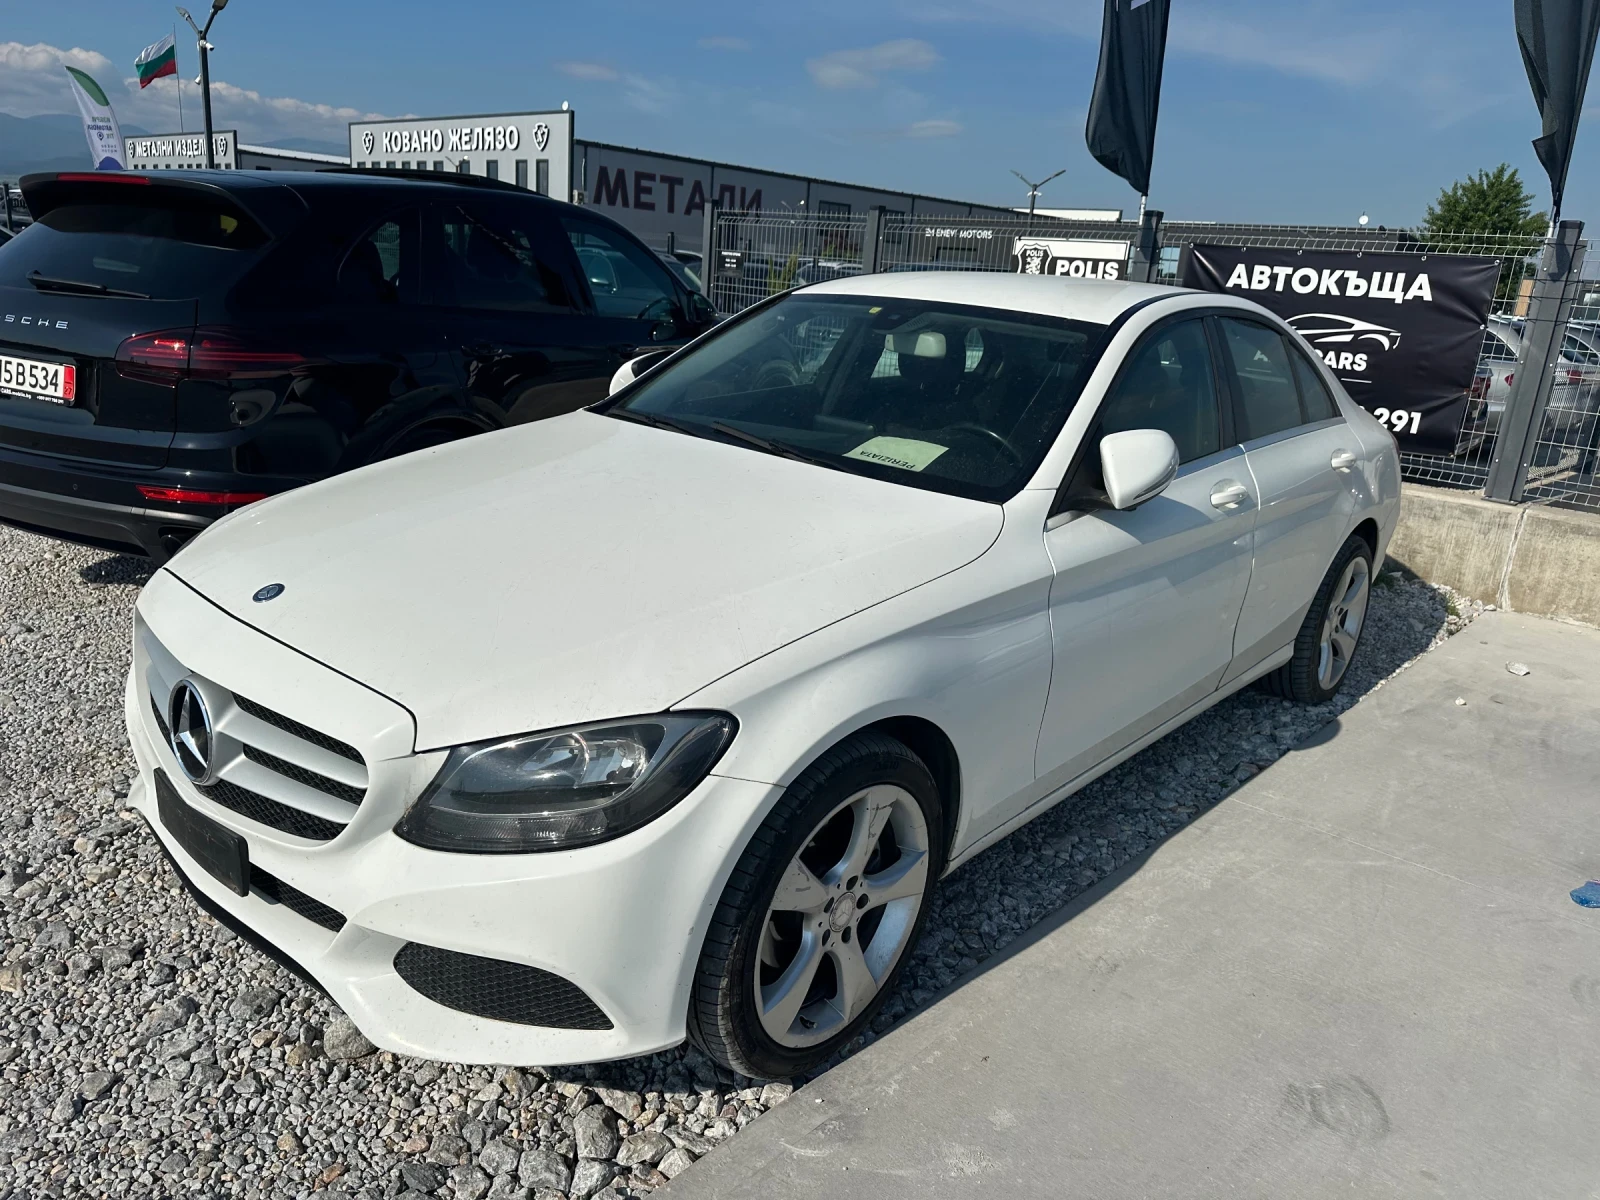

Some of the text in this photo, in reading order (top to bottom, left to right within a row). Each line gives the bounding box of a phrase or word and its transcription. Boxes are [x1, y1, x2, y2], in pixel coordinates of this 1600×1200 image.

[136, 140, 174, 158] МЕТАЛНИ
[175, 137, 217, 158] ИЗДЕЛ
[382, 125, 520, 154] КОВАНО ЖЕЛЯЗО
[593, 166, 763, 218] МЕТАЛИ
[959, 229, 993, 239] MOTORS
[1026, 249, 1044, 257] POLIS
[1055, 259, 1119, 281] POLIS
[1226, 263, 1433, 304] АВТОКЪЩА
[0, 314, 69, 329] SCHE
[860, 450, 916, 468] PERIZIATA
